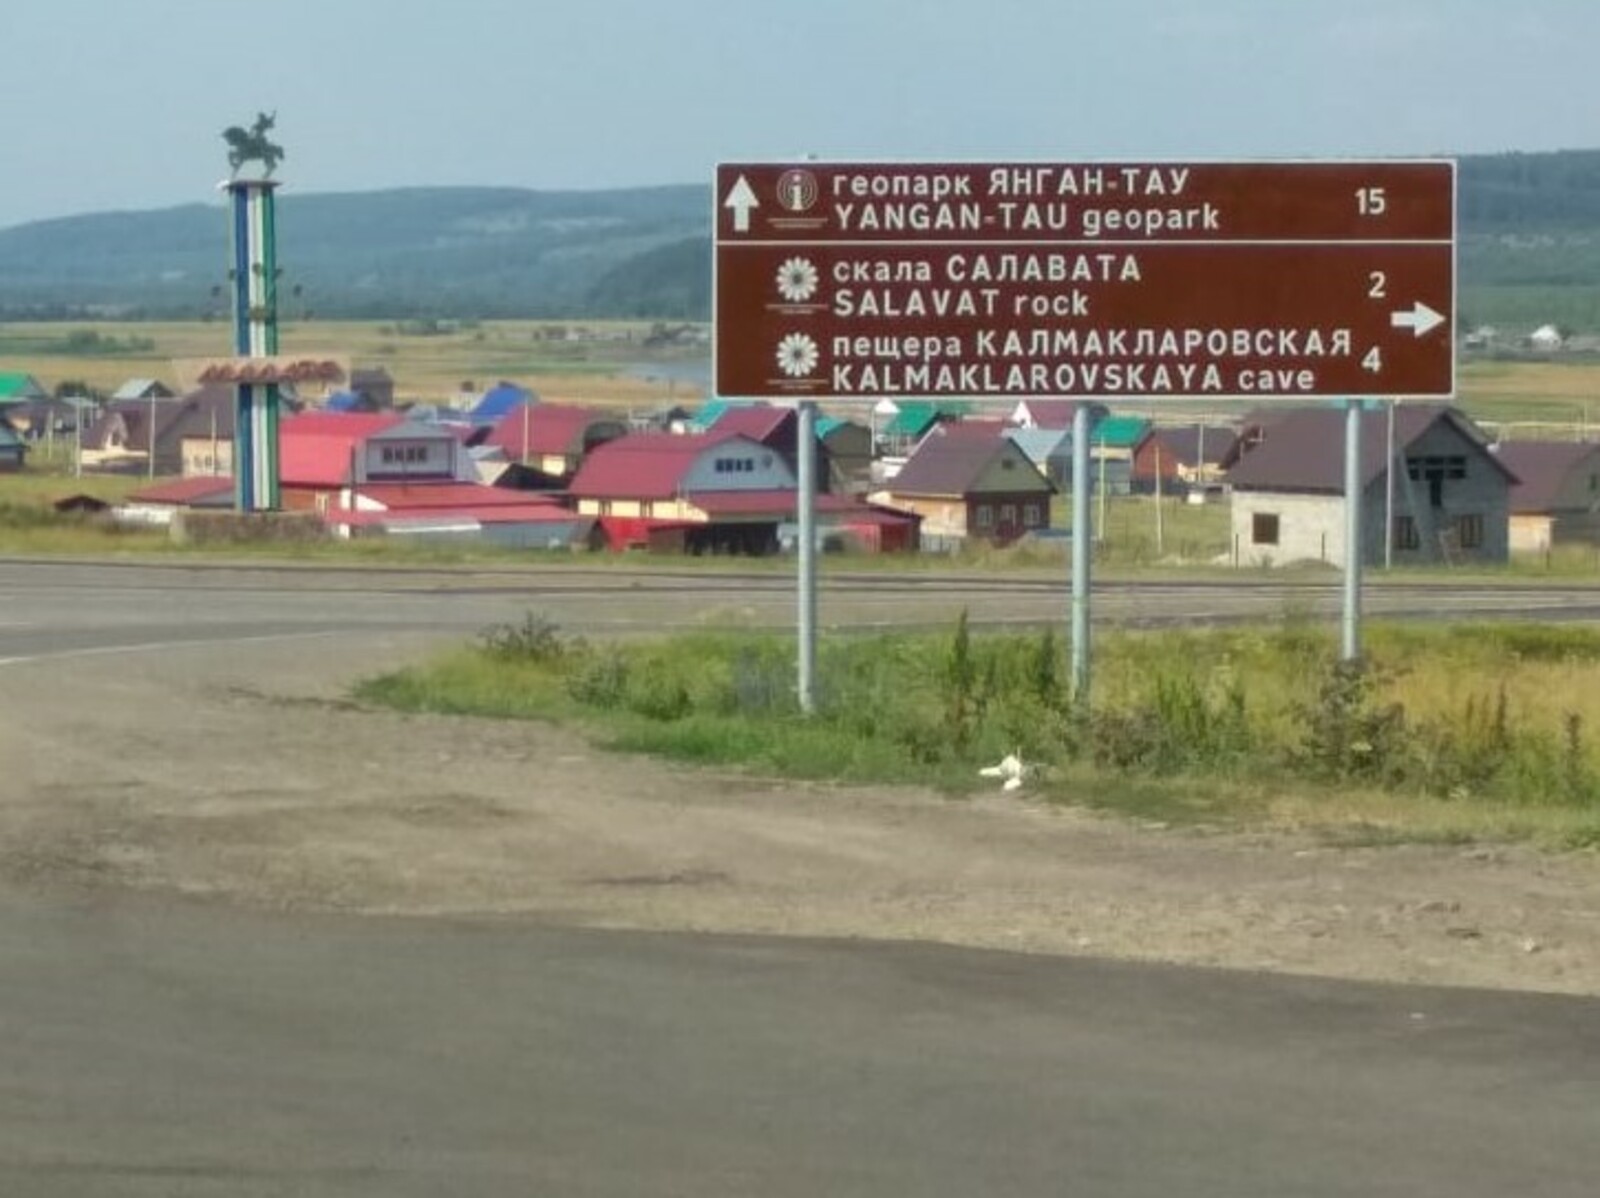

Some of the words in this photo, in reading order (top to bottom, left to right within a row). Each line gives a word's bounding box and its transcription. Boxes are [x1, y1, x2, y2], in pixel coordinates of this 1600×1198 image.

[833, 175, 971, 201] геопарк
[989, 169, 1188, 194] ЯНГАН-ТАУ
[1355, 188, 1386, 215] 15
[836, 203, 1066, 229] YANGAN-TAU
[1084, 203, 1219, 236] geopark
[834, 262, 930, 281] скала
[947, 255, 1140, 281] САЛАВАТА
[1368, 271, 1386, 298] 2
[835, 290, 998, 316] SALAVAT
[1016, 290, 1087, 315] rock
[833, 336, 962, 362] пещера
[978, 330, 1350, 355] КАЛМАКЛАРОВСКАЯ
[1361, 346, 1382, 372] 4
[833, 364, 1222, 391] KALMAKLAROVSKAYA
[1239, 370, 1315, 390] cave
